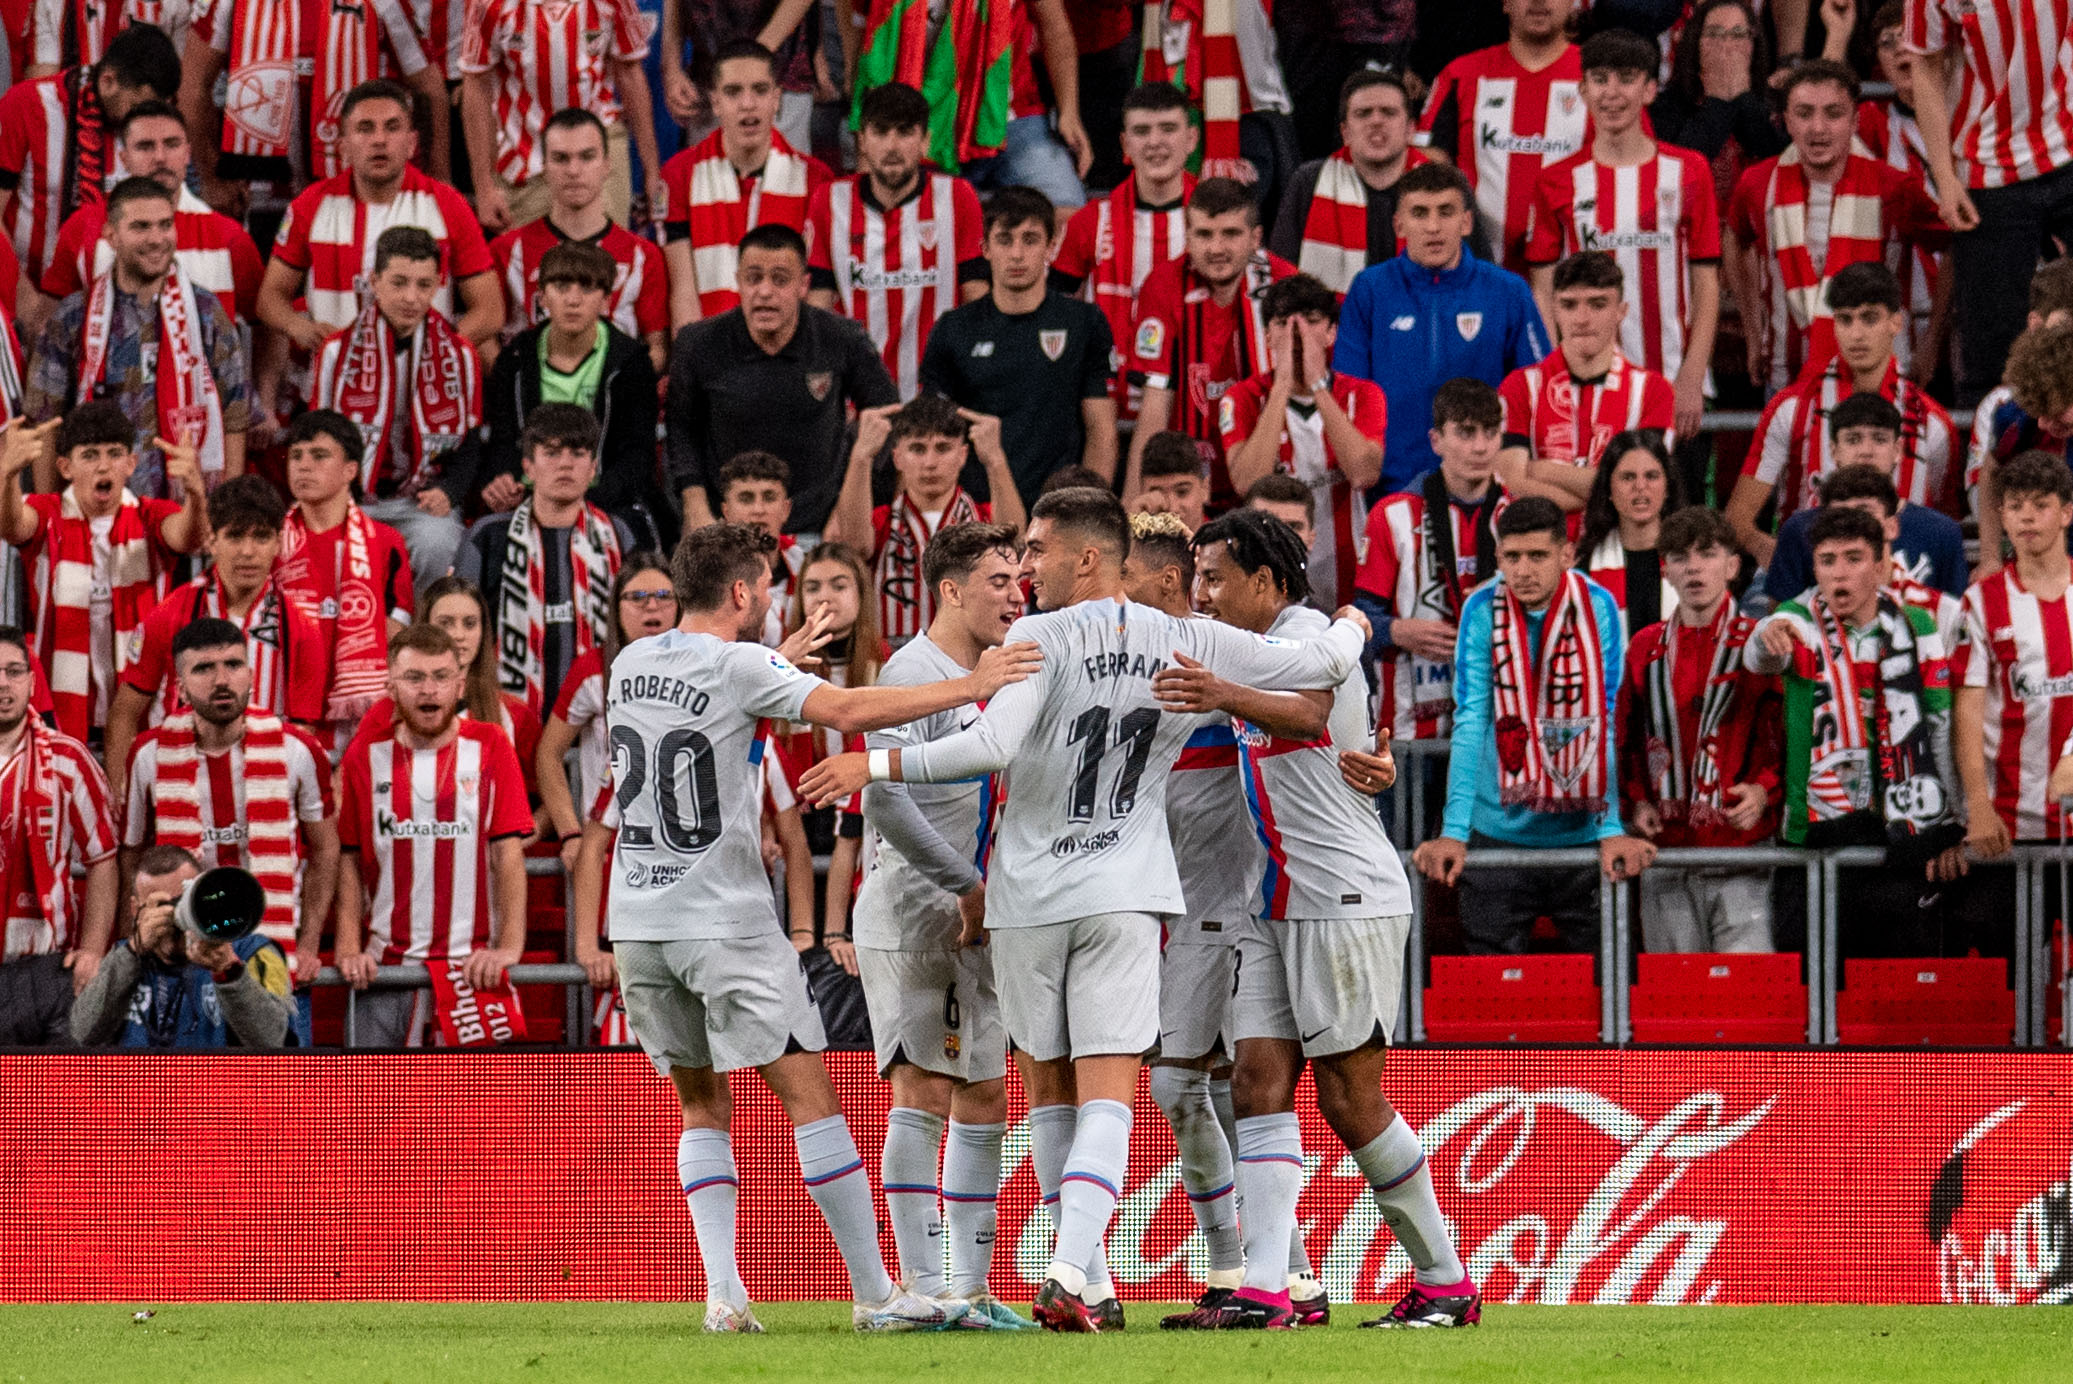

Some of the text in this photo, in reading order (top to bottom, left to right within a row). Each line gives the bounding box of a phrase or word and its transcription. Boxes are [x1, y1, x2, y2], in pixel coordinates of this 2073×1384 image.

[620, 675, 710, 717] ROBERTO
[609, 724, 723, 855] 20
[1066, 704, 1162, 824] 11
[942, 981, 960, 1030] 6
